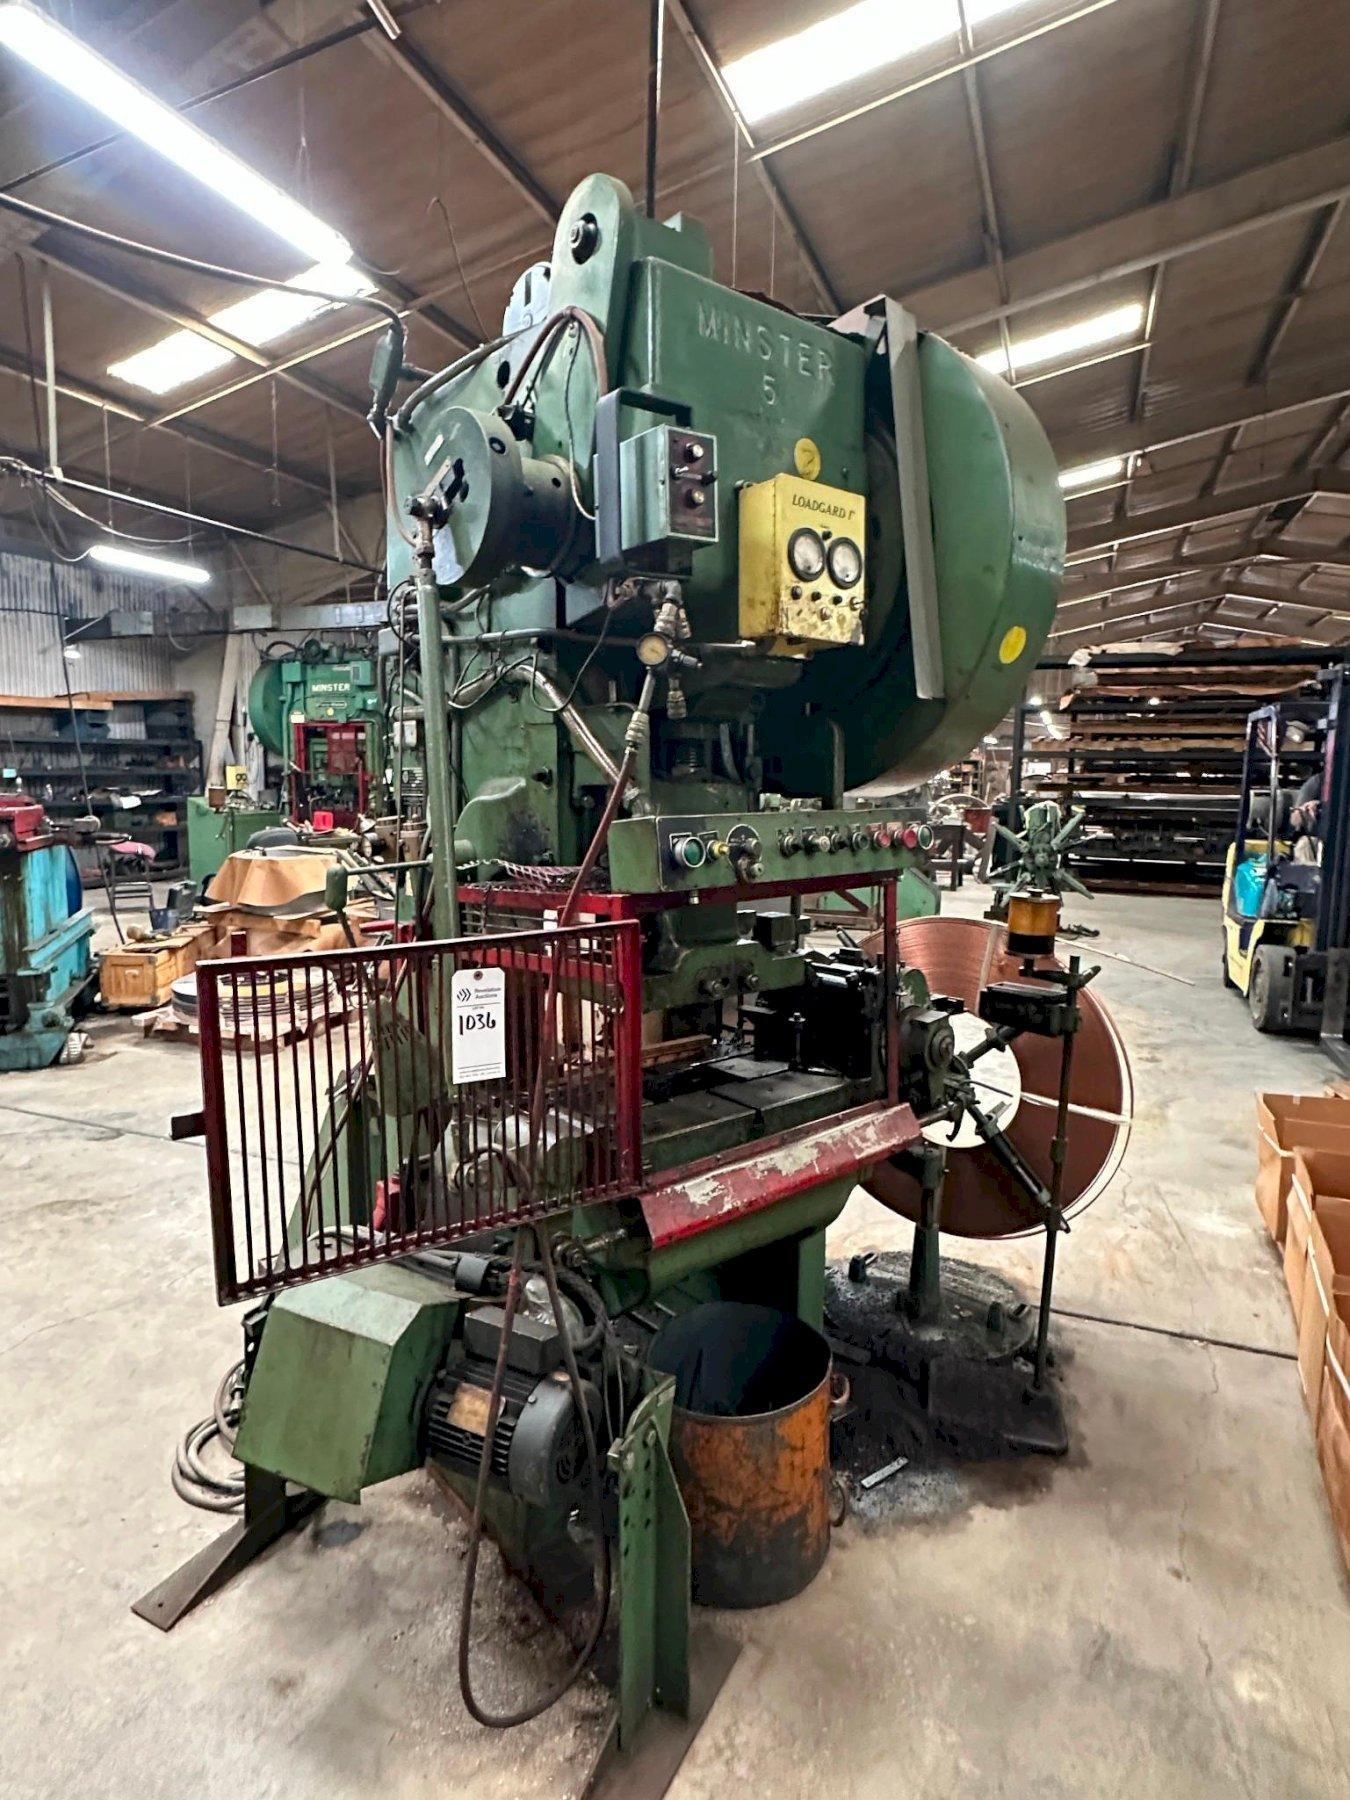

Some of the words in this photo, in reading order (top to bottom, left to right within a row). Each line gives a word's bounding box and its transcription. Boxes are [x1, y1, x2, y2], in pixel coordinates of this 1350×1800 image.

[698, 299, 834, 384] MINSTER
[762, 373, 777, 406] 5
[791, 493, 846, 519] LOADGARD
[311, 682, 351, 693] MINSTER
[458, 1011, 497, 1036] 1036
